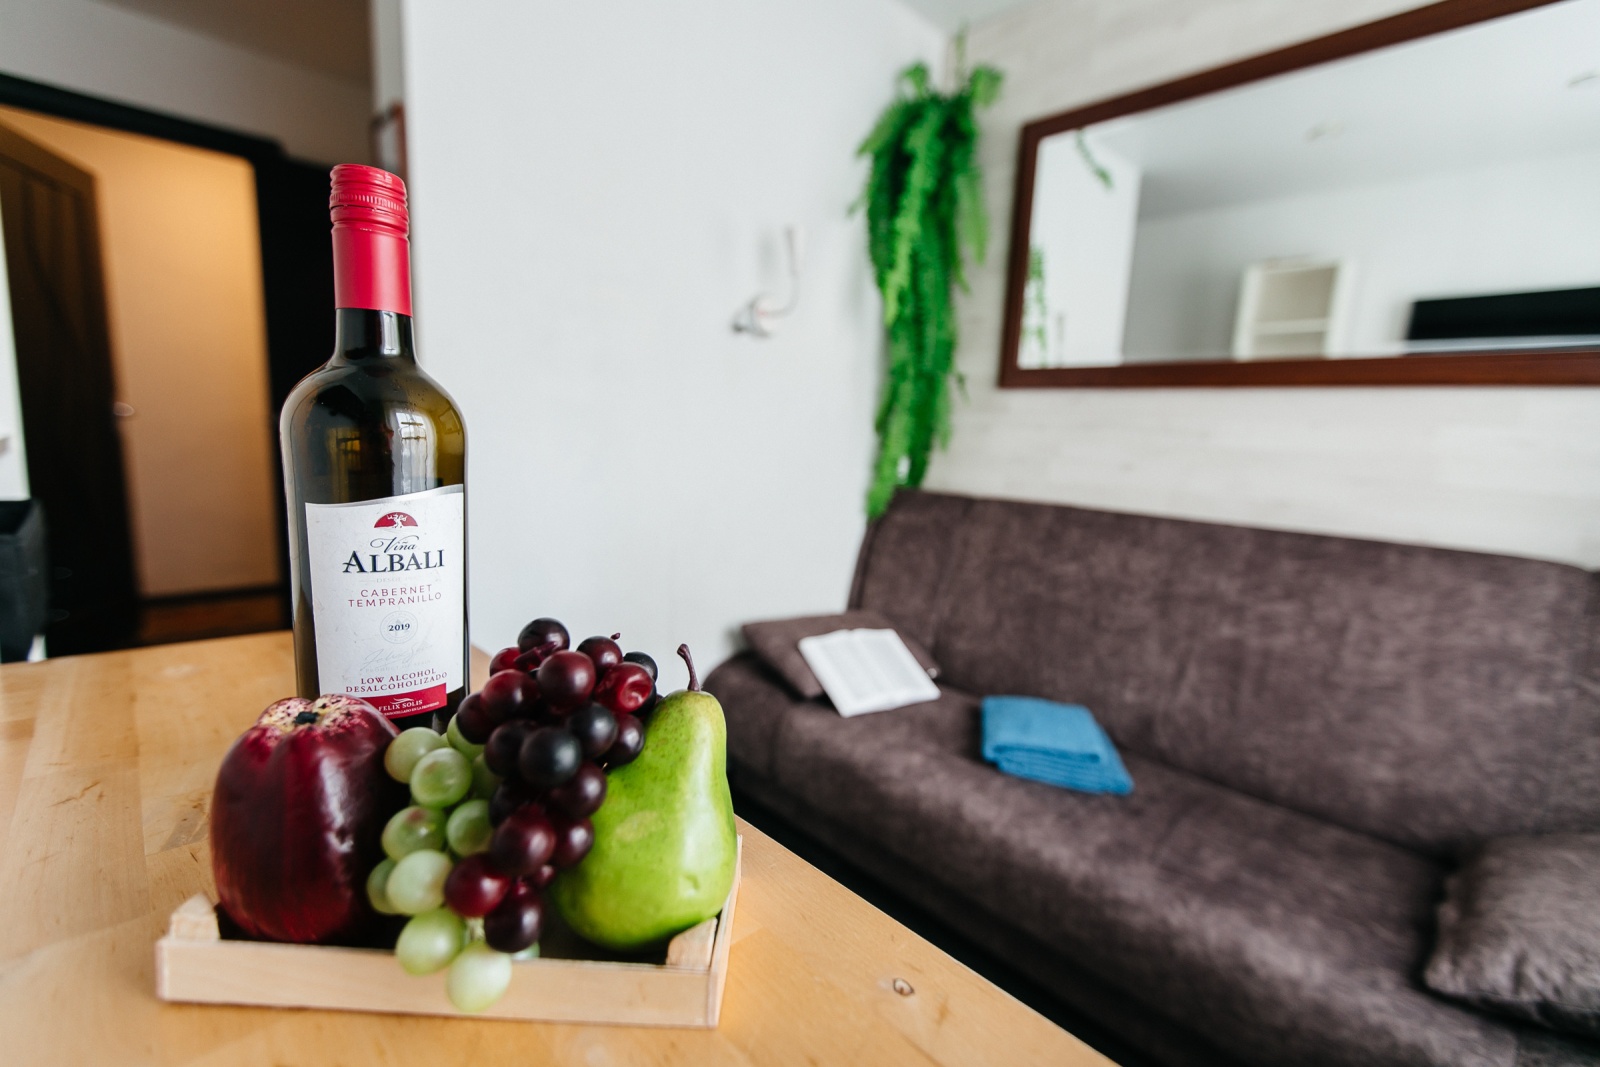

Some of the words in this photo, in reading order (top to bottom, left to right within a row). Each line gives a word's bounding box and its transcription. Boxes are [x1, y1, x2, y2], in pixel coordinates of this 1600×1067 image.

[370, 535, 419, 553] Viña
[342, 549, 445, 573] ALBALI
[360, 584, 432, 598] CABERNET
[348, 592, 442, 608] TEMPRANILLO
[388, 623, 411, 632] 2019
[345, 672, 448, 693] DESALCOHOLIZADO
[361, 675, 385, 685] LOW
[388, 668, 436, 682] ALCOHOL
[378, 704, 401, 712] FELIX
[402, 699, 423, 709] SOLIS
